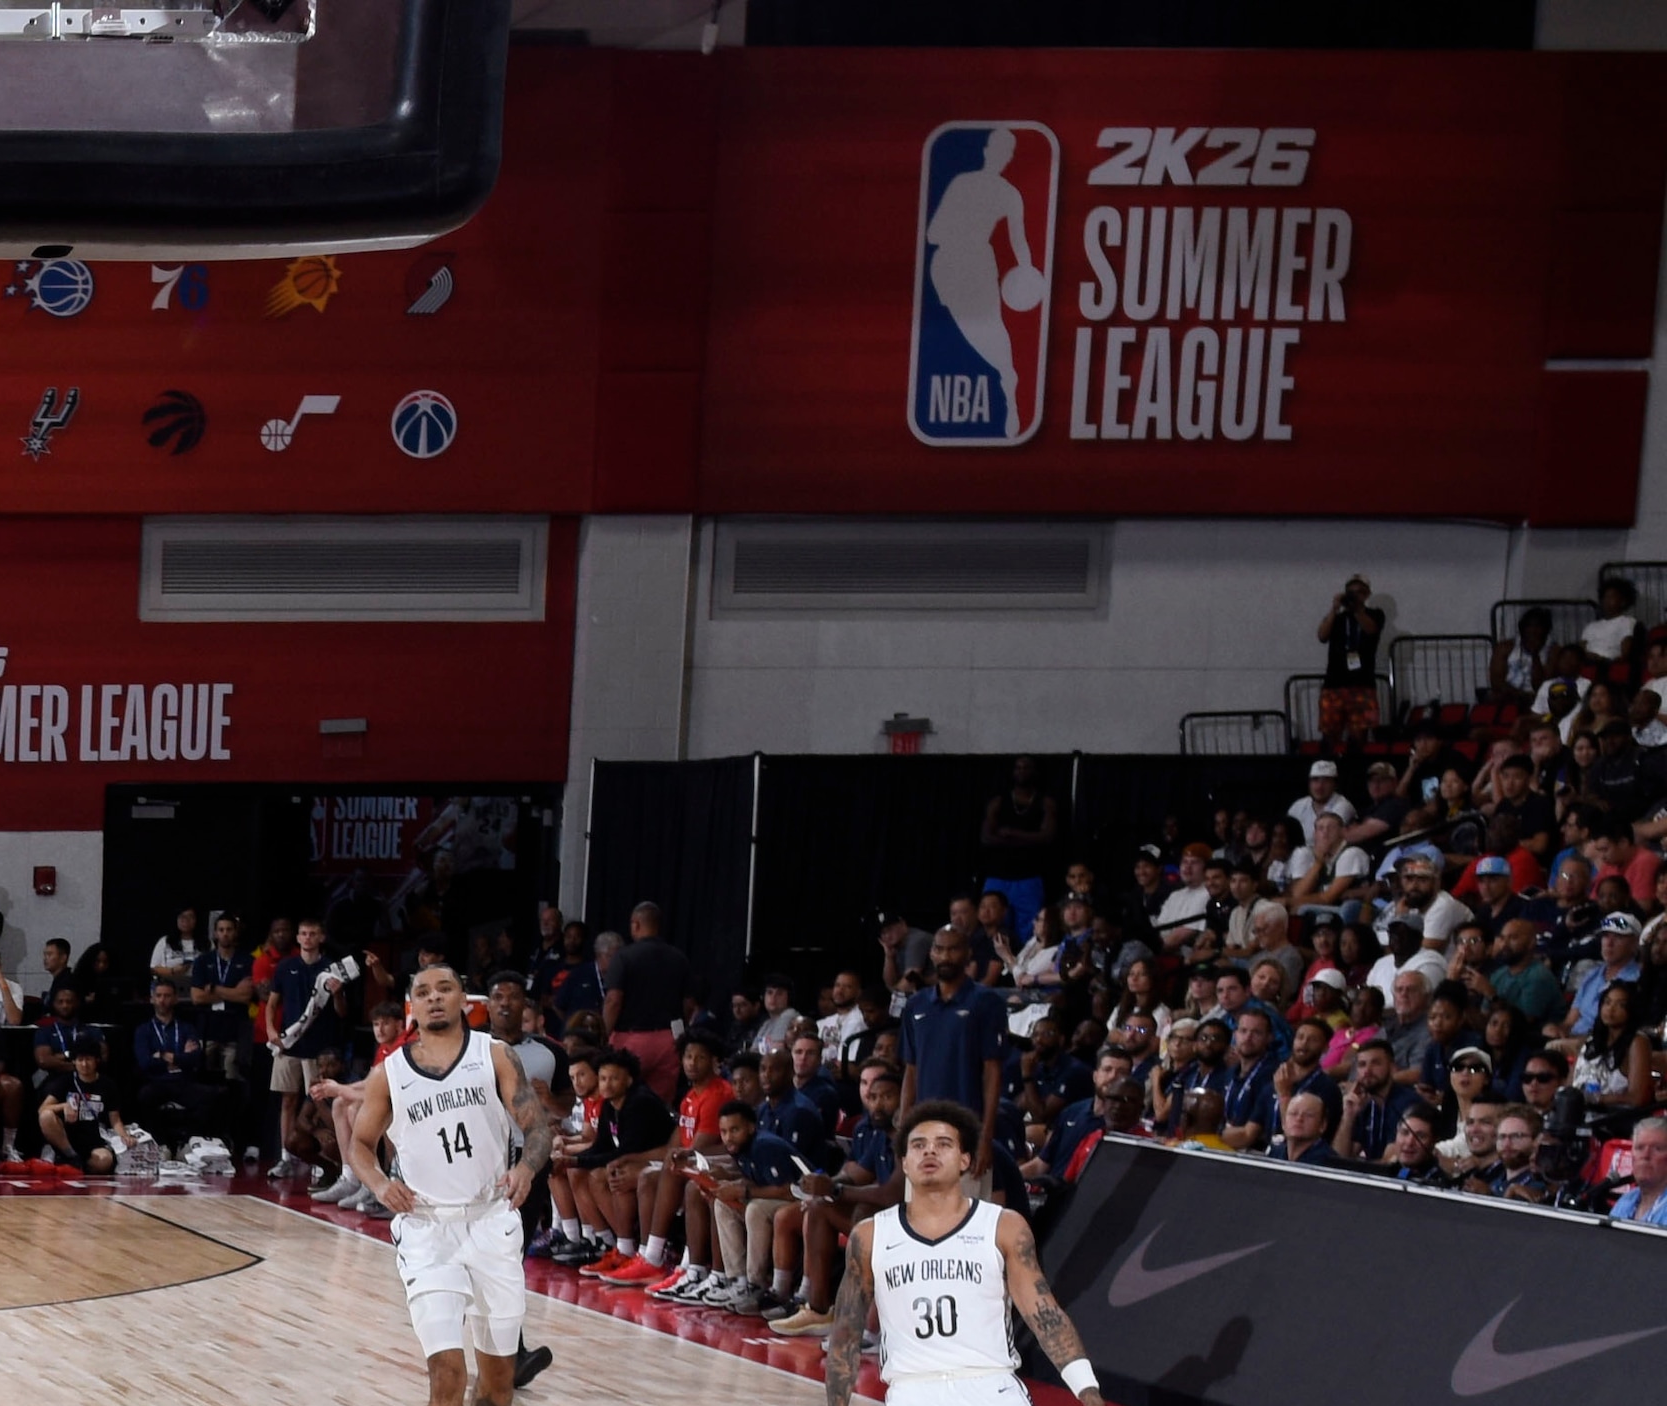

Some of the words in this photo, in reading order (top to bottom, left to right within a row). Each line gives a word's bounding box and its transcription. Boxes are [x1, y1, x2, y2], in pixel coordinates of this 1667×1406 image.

[1087, 127, 1317, 187] 2K26
[1078, 207, 1353, 323] SUMMER
[929, 374, 991, 424] NBA
[1069, 327, 1301, 441] LEAGUE
[79, 683, 233, 761] LEAGUE
[333, 796, 419, 821] SUMMER
[332, 822, 404, 860] LEAGUE
[406, 1097, 433, 1126] NEW
[436, 1086, 487, 1113] ORLEANS
[437, 1121, 473, 1164] 14
[884, 1261, 916, 1292] NEW
[920, 1258, 983, 1285] ORLEANS
[912, 1294, 959, 1340] 30
